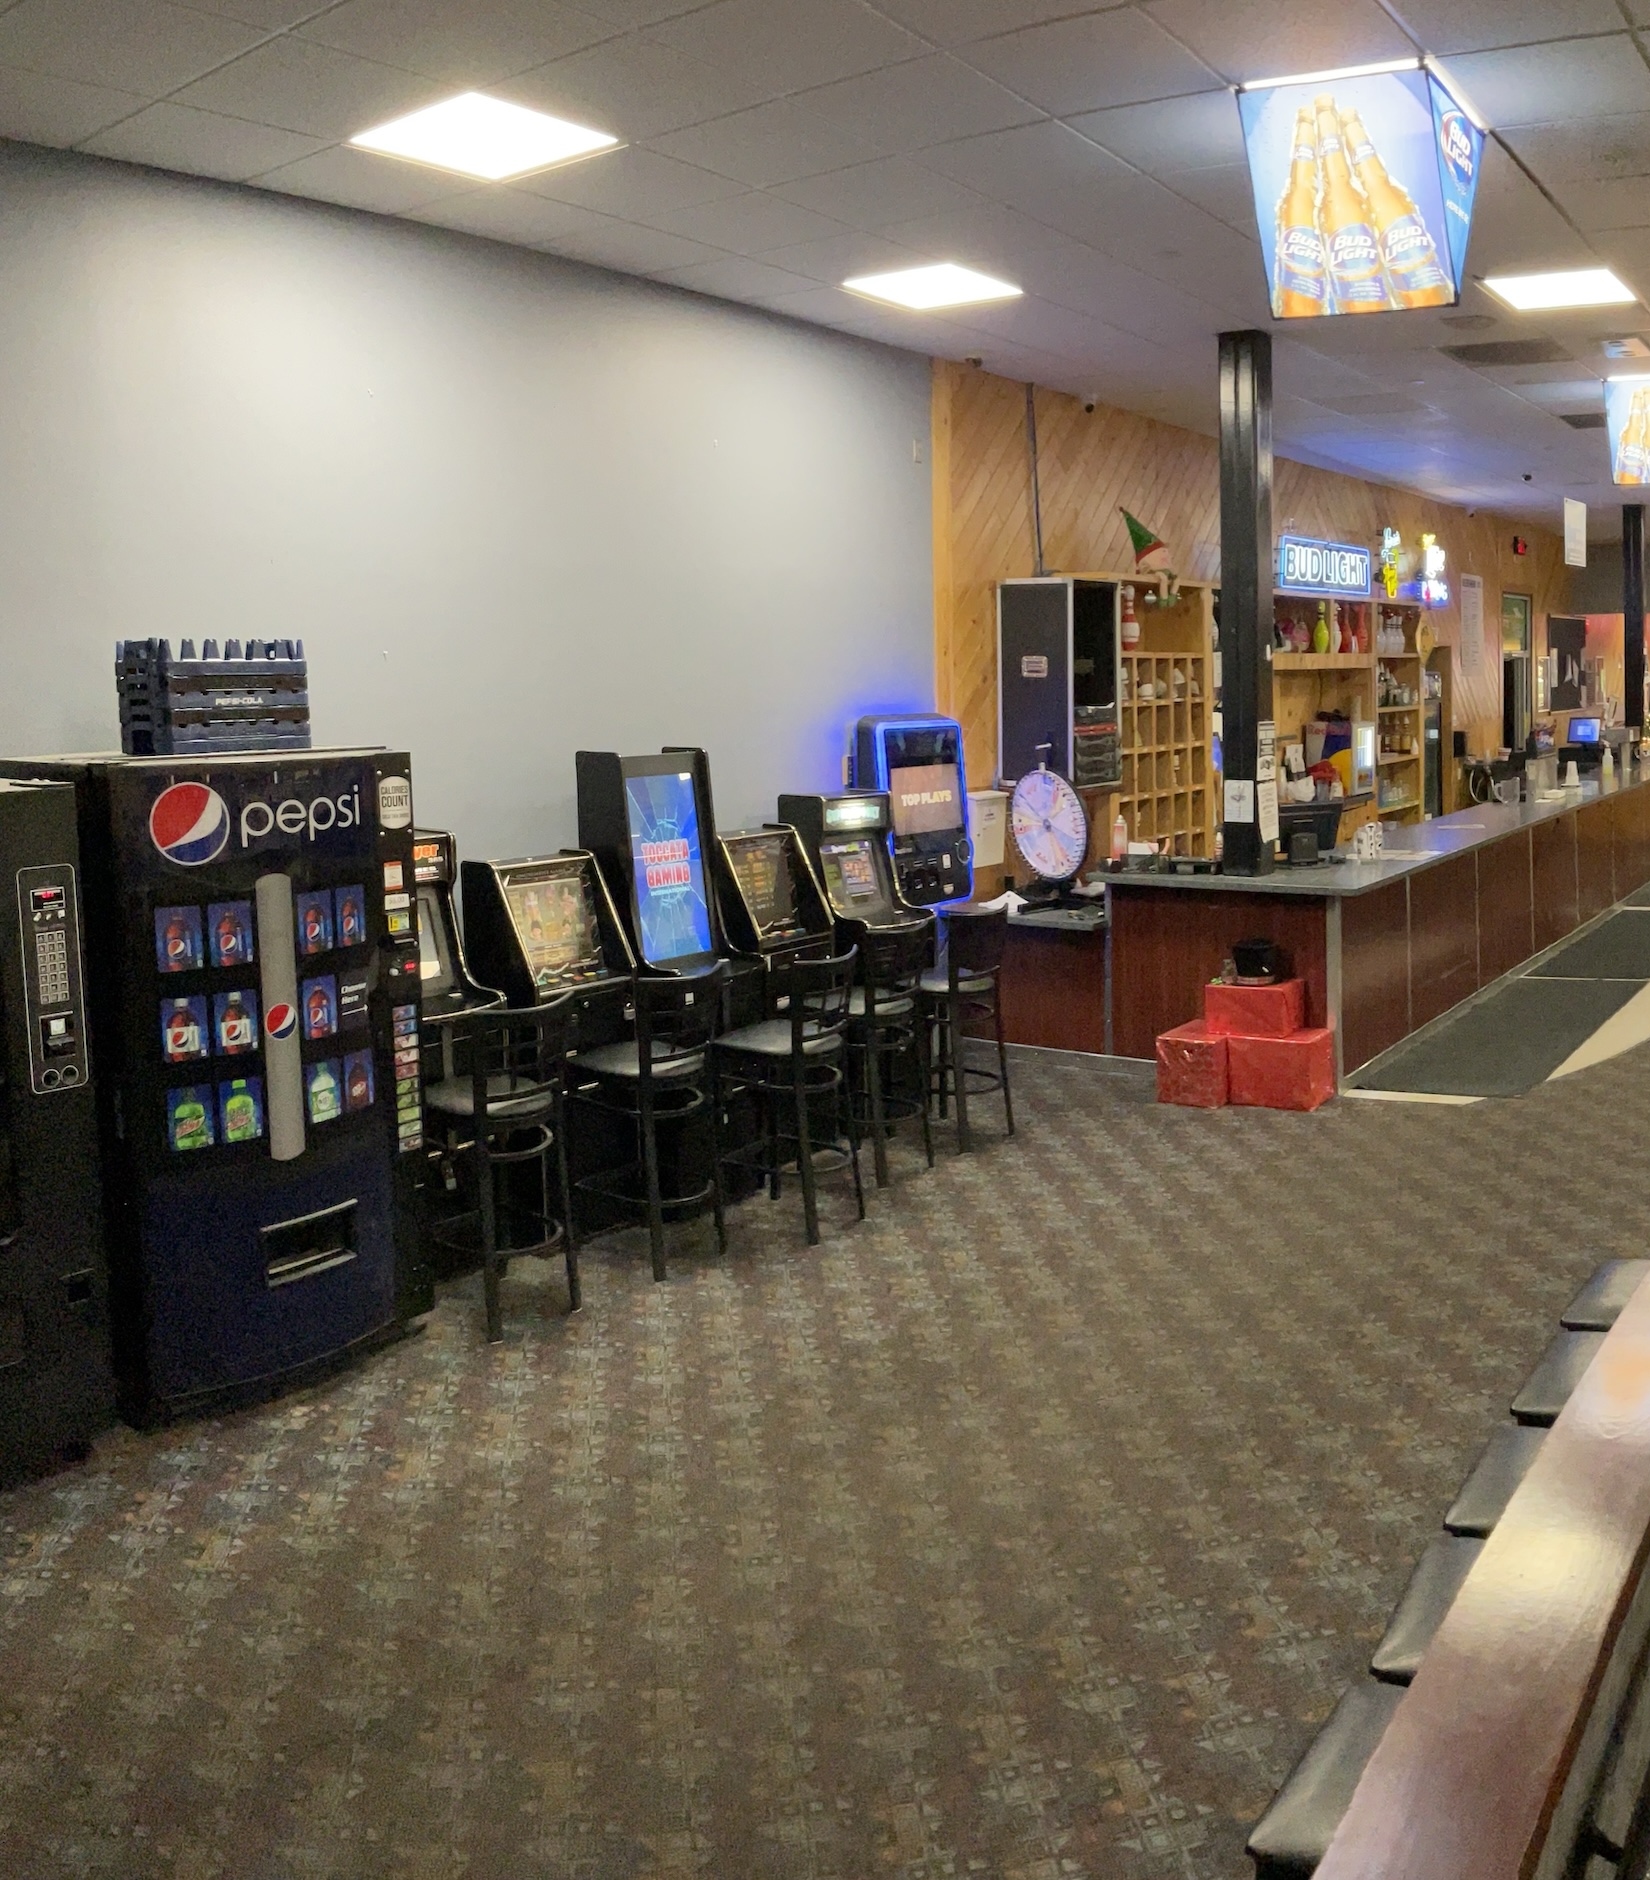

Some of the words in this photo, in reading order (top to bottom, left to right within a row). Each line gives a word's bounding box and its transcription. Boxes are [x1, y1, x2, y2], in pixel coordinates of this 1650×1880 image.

[1450, 120, 1471, 156] BUD
[1447, 137, 1473, 176] LIGHT
[1288, 232, 1321, 250] BUD
[1334, 234, 1372, 249] BUD
[1387, 225, 1423, 243] BUD
[1330, 246, 1377, 265] LIGHT
[1385, 236, 1430, 260] LIGHT
[1285, 544, 1322, 582] BUD
[1323, 550, 1368, 587] LIGHT
[215, 696, 264, 706] PEPSI-COLA
[380, 785, 409, 795] CALORIES
[901, 793, 920, 807] TOP
[920, 790, 952, 805] PLAYS
[381, 794, 409, 808] COUNT
[241, 784, 361, 848] pepsi
[641, 838, 690, 866] TOCCATA
[646, 861, 691, 888] GAMING
[341, 982, 367, 995] Choose
[341, 995, 359, 1005] Here
